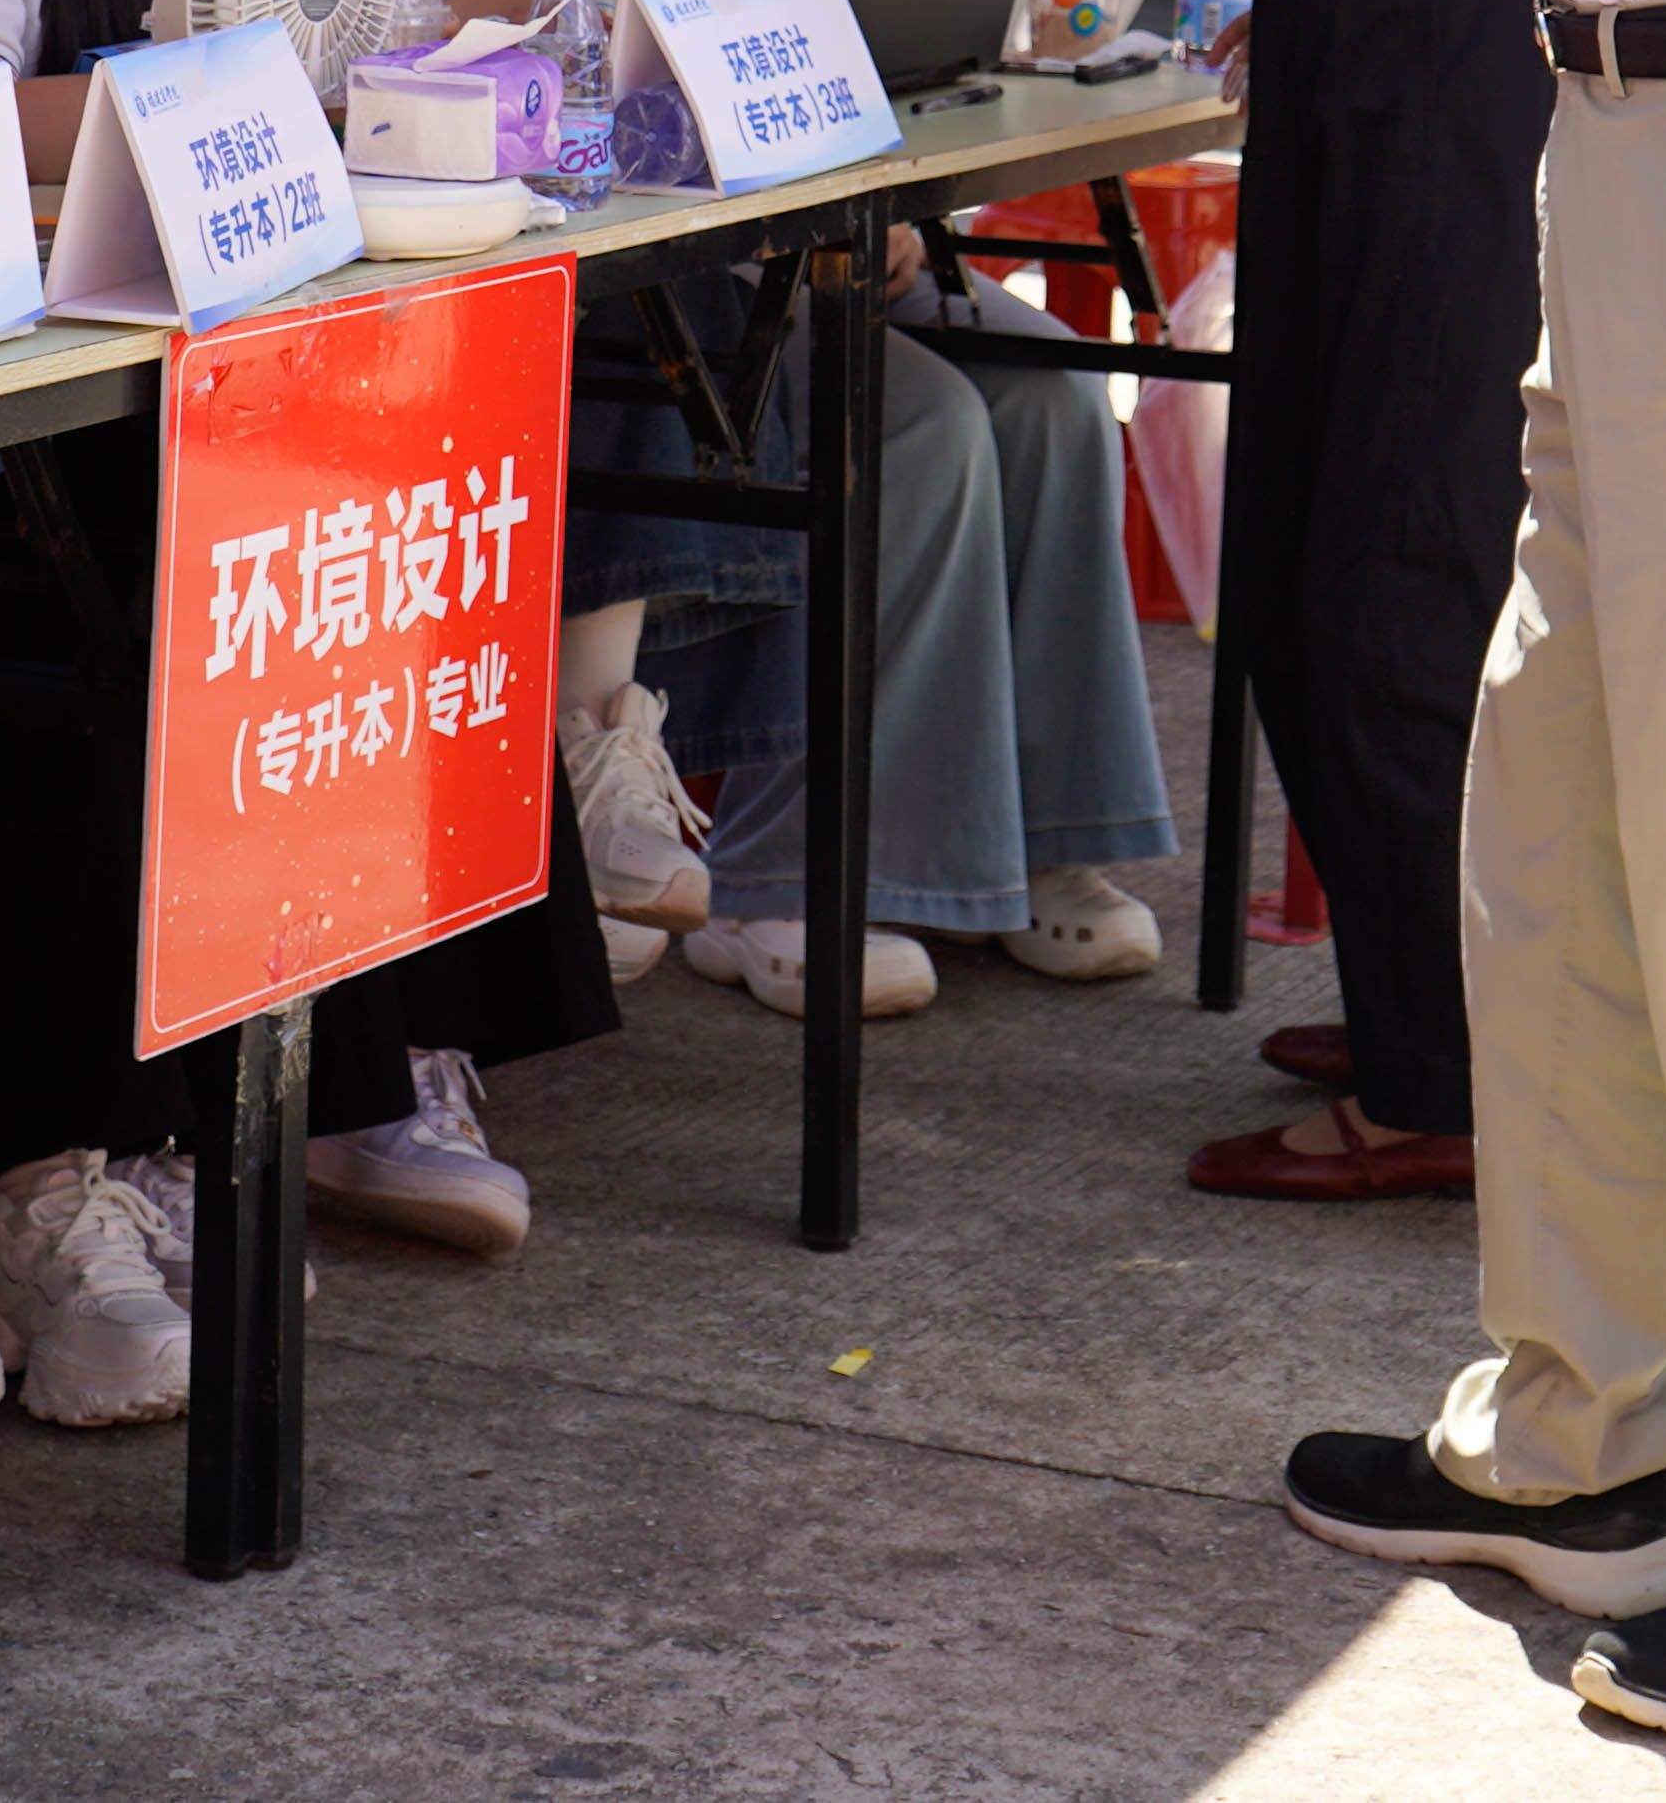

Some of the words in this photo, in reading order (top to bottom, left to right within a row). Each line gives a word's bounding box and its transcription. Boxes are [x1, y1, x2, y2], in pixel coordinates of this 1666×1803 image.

[721, 23, 815, 85] 环境设计
[189, 111, 283, 192] 环境设计
[733, 76, 862, 152] (专升本)3班
[198, 171, 326, 276] (专升本)2班
[205, 455, 530, 684] 环境设计
[231, 642, 510, 815] (专升本)专业
